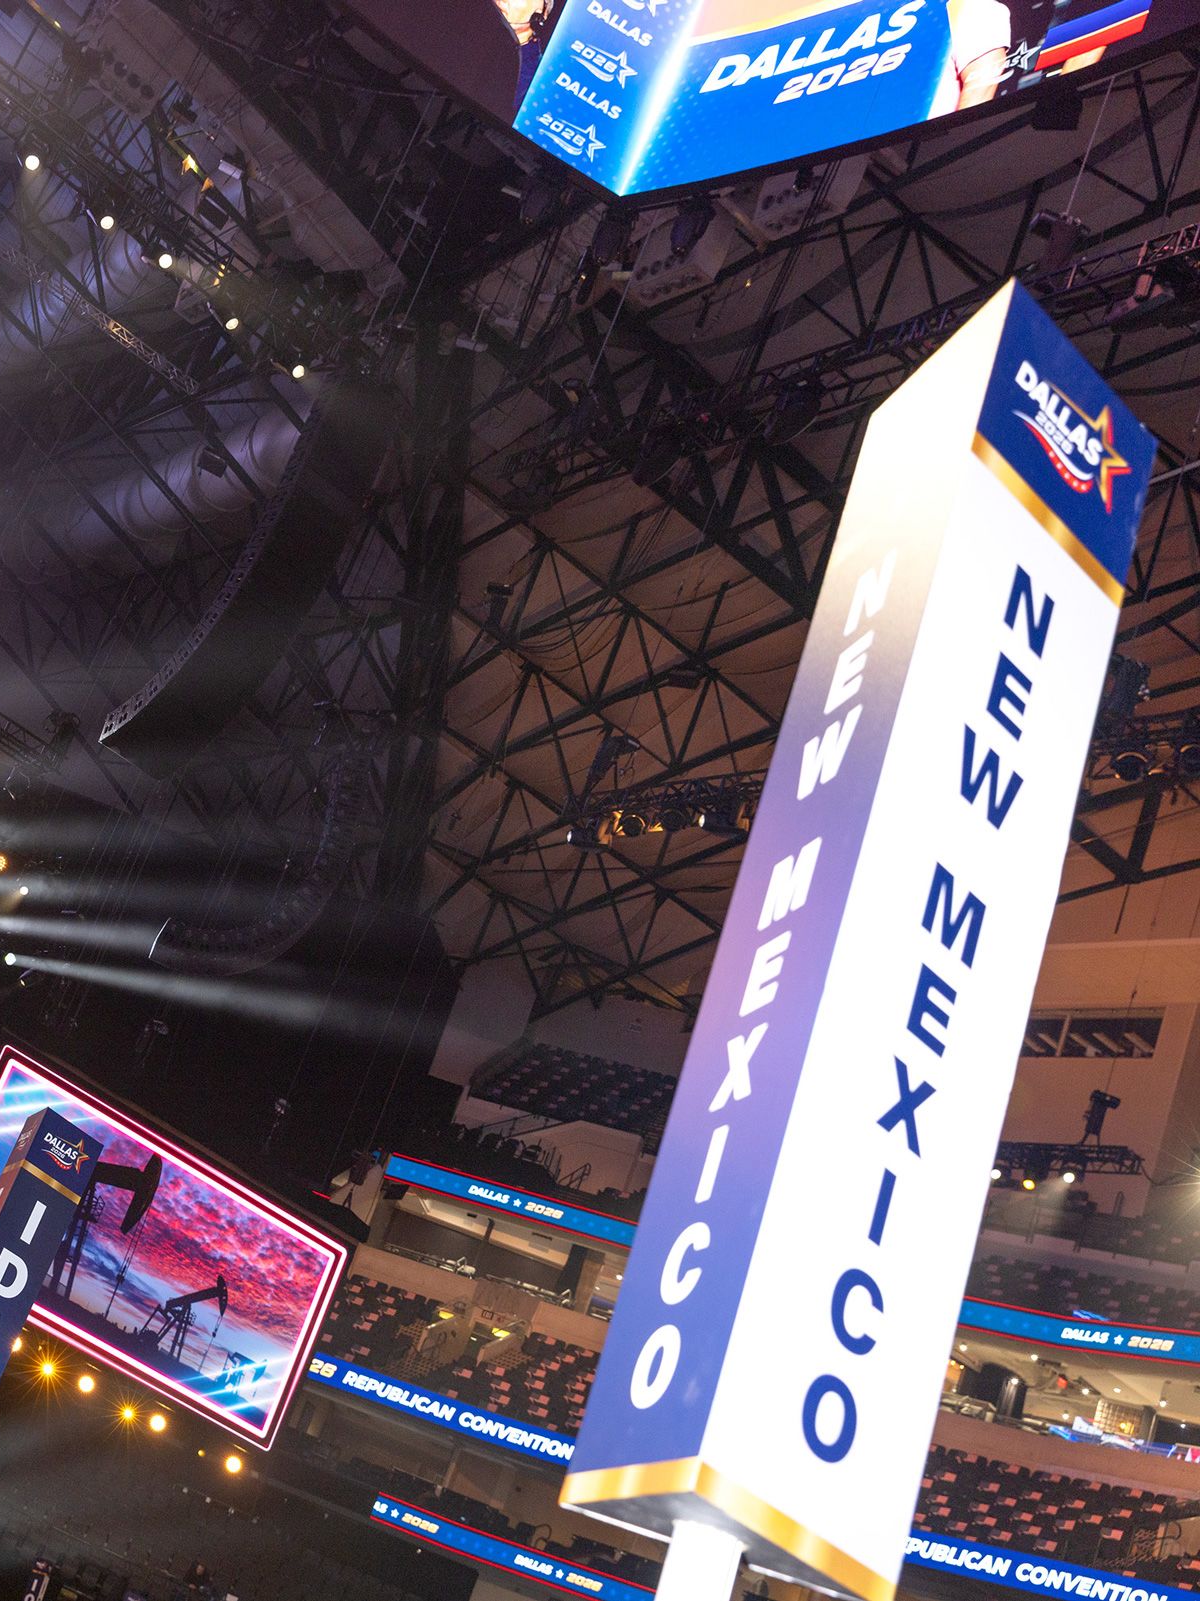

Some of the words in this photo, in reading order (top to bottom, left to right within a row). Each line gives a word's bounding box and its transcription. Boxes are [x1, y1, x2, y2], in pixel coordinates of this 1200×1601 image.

[586, 0, 653, 47] DALLAS
[699, 0, 928, 94] DALLAS
[570, 39, 618, 73] 2026
[773, 43, 913, 105] 2026
[555, 72, 623, 120] DALLAS
[538, 113, 587, 147] 2026
[1014, 360, 1104, 466] DALLAS
[1035, 410, 1075, 455] 2026
[797, 546, 897, 801] NEW
[961, 563, 1055, 830] NEW
[43, 1132, 78, 1160] DALLAS
[630, 836, 822, 1410] MEXICO
[50, 1146, 66, 1159] 2026
[802, 862, 986, 1463] MEXICO
[468, 1184, 510, 1205] DALLAS
[524, 1201, 564, 1220] 2026
[1061, 1327, 1110, 1345] DALLAS
[1127, 1335, 1175, 1351] 2026
[342, 1370, 457, 1422] REPUBLICAN
[458, 1411, 575, 1460] CONVENTION
[401, 1512, 440, 1534] 2026
[514, 1553, 554, 1576] DALLAS
[565, 1572, 603, 1593] 2026
